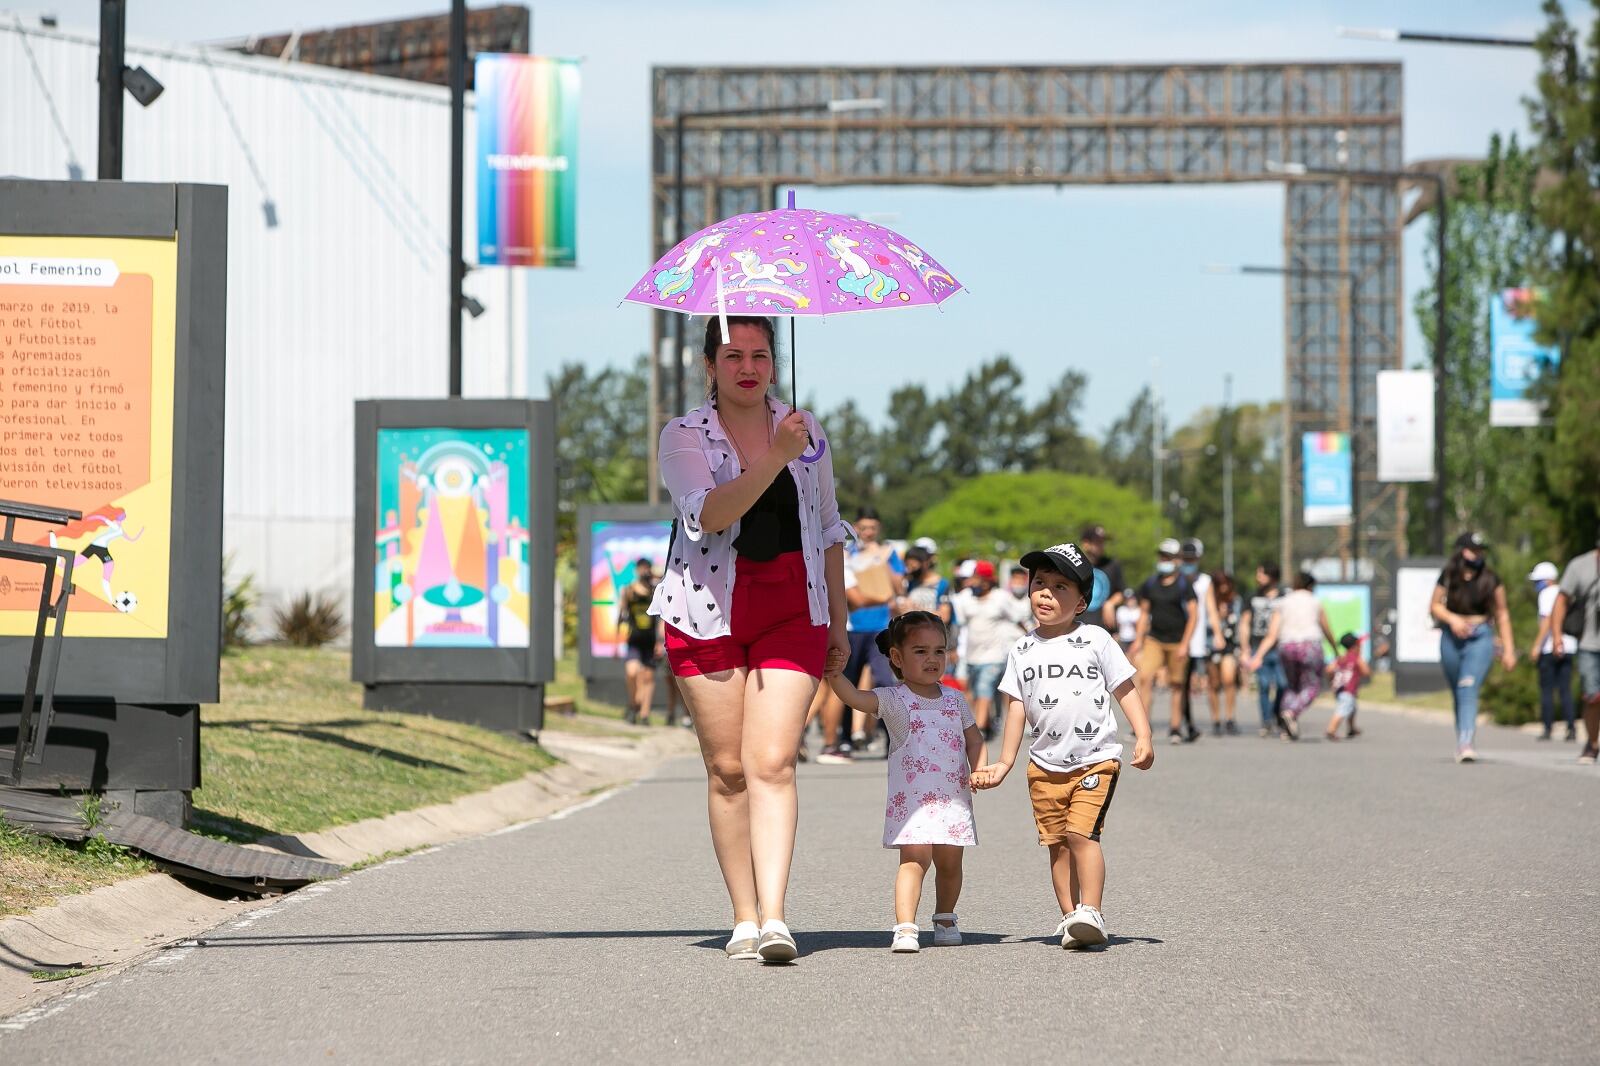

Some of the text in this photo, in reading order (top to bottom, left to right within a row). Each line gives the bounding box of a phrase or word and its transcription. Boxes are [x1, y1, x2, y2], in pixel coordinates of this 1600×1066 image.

[30, 262, 102, 276] Femenino
[0, 302, 34, 312] marzo
[41, 302, 54, 313] de
[105, 303, 118, 314] la
[12, 316, 33, 328] del
[5, 333, 97, 346] y Futbolistas
[12, 349, 82, 361] Agremiados
[12, 365, 110, 378] oficialización
[12, 382, 67, 393] femenino
[75, 386, 82, 395] y
[90, 383, 124, 394] firmó
[11, 399, 39, 410] para
[46, 398, 67, 410] dar
[75, 399, 117, 410] inicio
[124, 401, 131, 411] a
[81, 415, 96, 426] En
[3, 430, 123, 442] primera vez todos
[25, 445, 45, 457] del
[54, 446, 95, 457] torneo
[102, 447, 116, 458] de
[53, 462, 73, 473] del
[82, 462, 122, 474] fútbol
[1023, 664, 1099, 682] DIDAS
